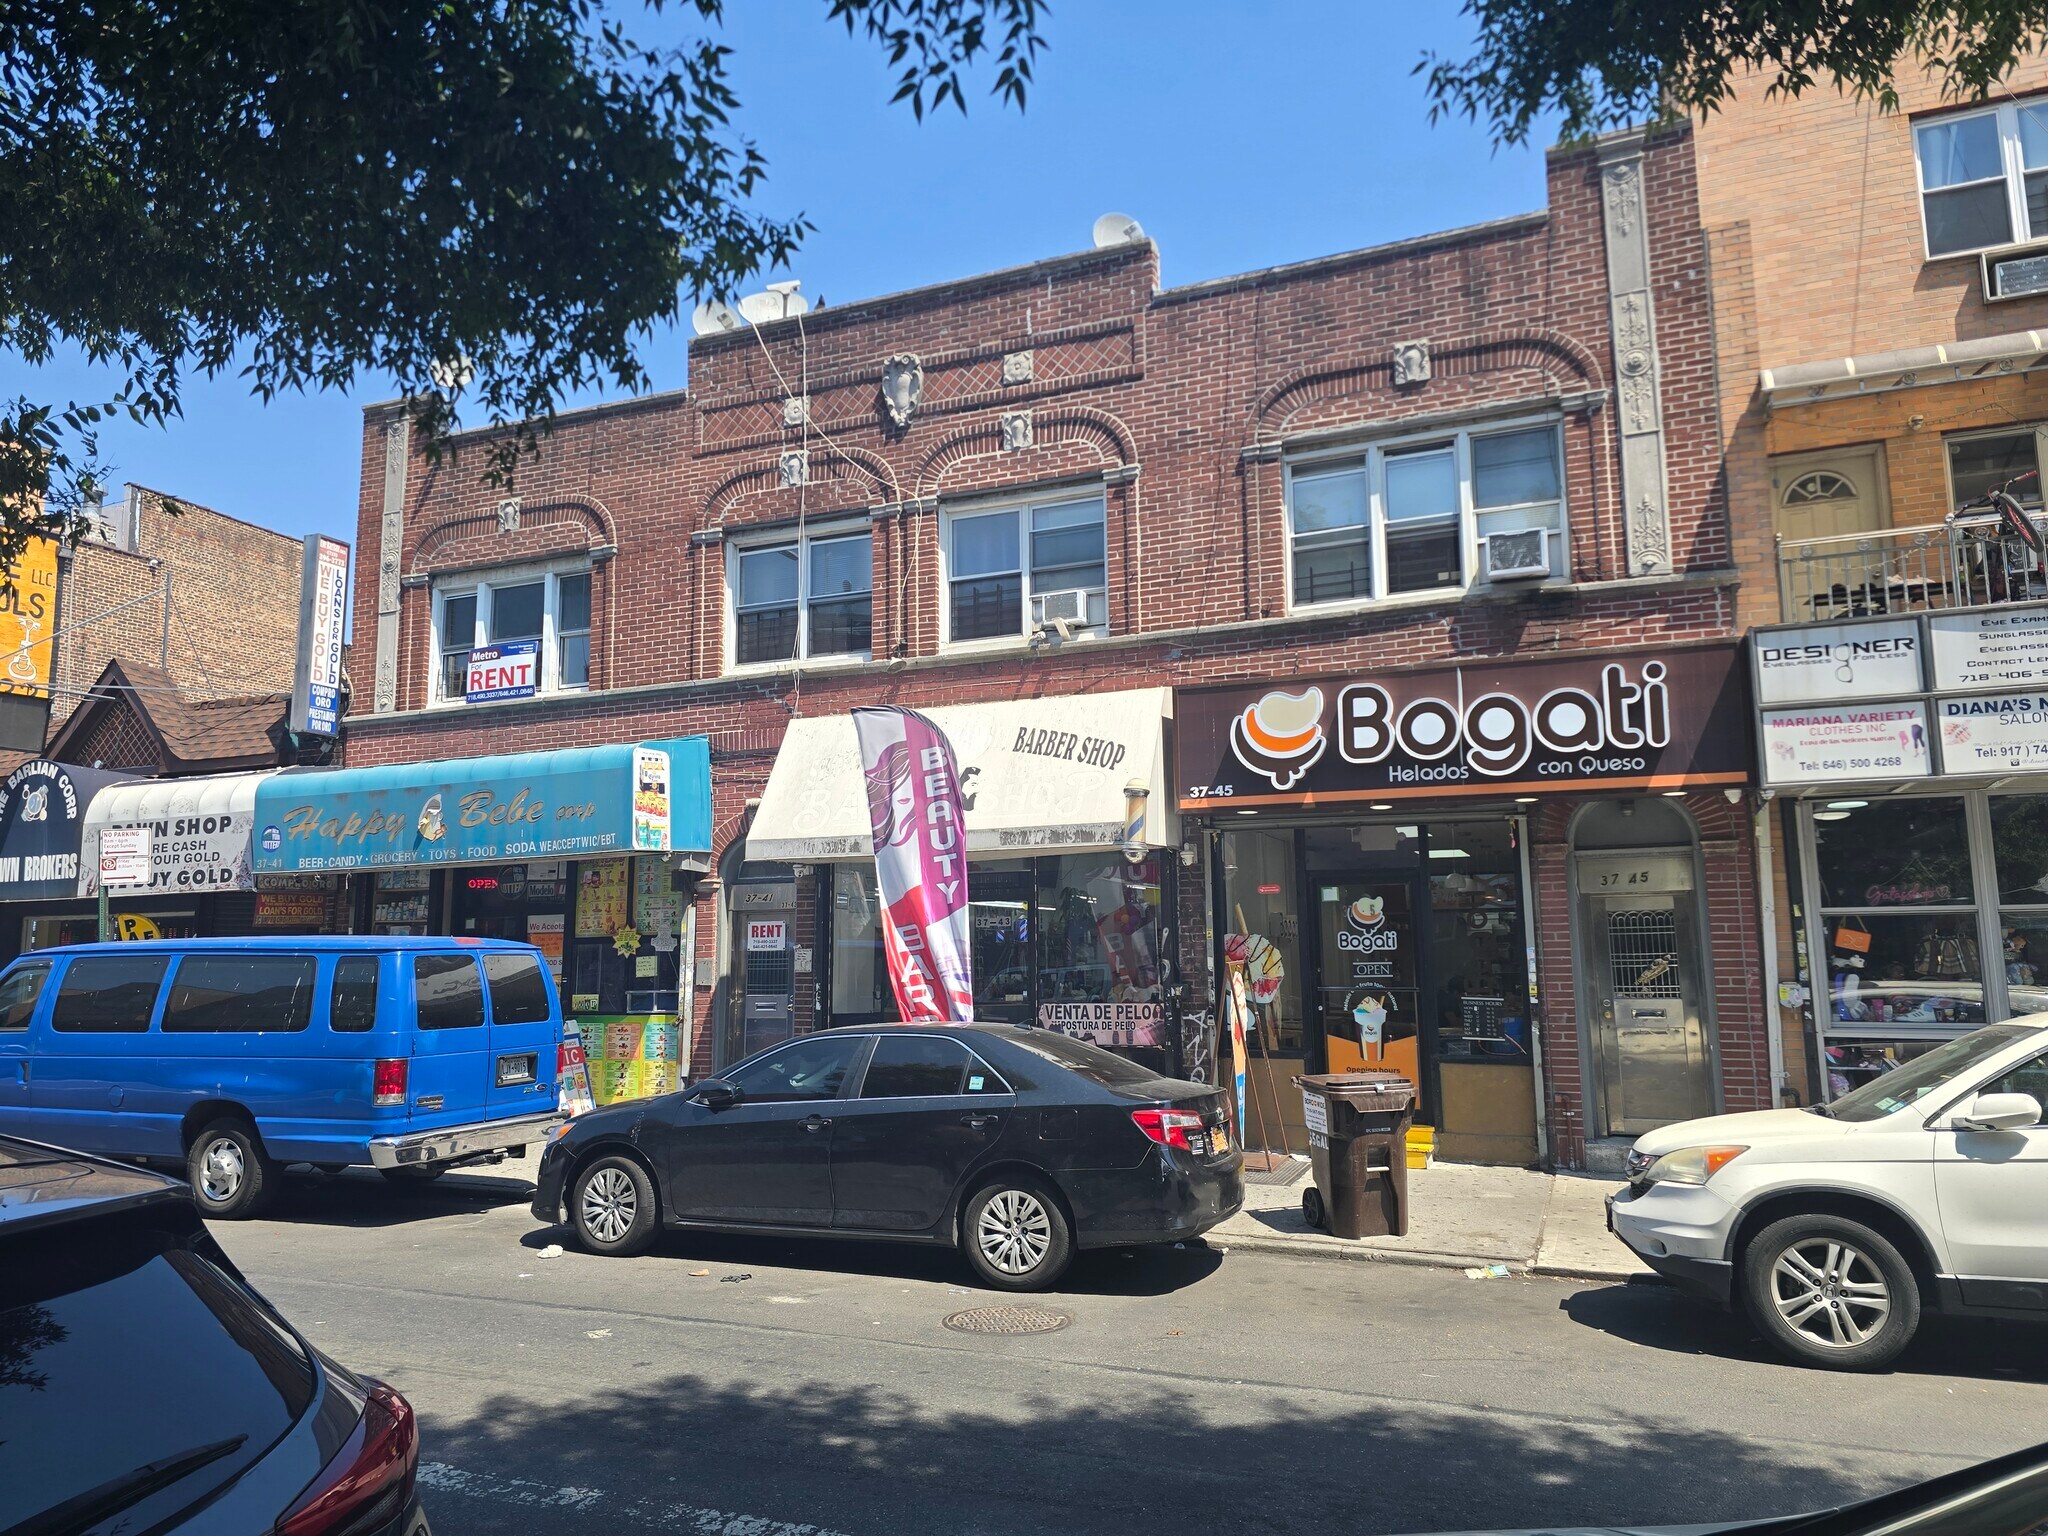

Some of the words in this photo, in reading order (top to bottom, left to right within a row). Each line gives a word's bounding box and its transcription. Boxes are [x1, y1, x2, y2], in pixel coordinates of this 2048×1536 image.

[32, 569, 56, 588] LLC.
[320, 564, 332, 590] WE
[333, 569, 343, 618] LOANS
[318, 593, 329, 628] BUY
[332, 621, 340, 640] FOR
[314, 632, 326, 681] GOLD
[328, 642, 339, 684] GOLD
[472, 651, 498, 661] Metro
[1967, 658, 2023, 668] CONTACT
[470, 664, 532, 691] RENT
[312, 684, 336, 699] COMPRO
[315, 696, 331, 709] ORO
[1947, 698, 2032, 715] DIANA'S
[1337, 660, 1670, 776] Bogati
[1772, 715, 1843, 728] MARIANA
[1848, 710, 1916, 723] VARIETY
[1809, 725, 1863, 736] CLOTHES
[1866, 723, 1887, 733] INC
[1012, 726, 1079, 761] BARBER
[1077, 736, 1126, 771] SHOP
[1975, 747, 1997, 757] Tel:
[2000, 746, 2021, 756] 917
[1388, 764, 1469, 783] Helados
[1537, 759, 1574, 775] con
[1578, 755, 1646, 776] Queso
[1799, 762, 1820, 771] Tel:
[1822, 759, 1847, 771] 646)
[1850, 759, 1870, 768] 500
[1874, 757, 1902, 767] 4268
[0, 790, 9, 821] HE
[7, 761, 59, 790] BARLIAN
[1189, 784, 1234, 798] 37-45
[283, 805, 406, 846] Happy
[457, 787, 544, 828] Bebe
[556, 801, 597, 822] corp
[174, 815, 232, 836] SHOP
[920, 746, 961, 905] BEAUTY
[172, 840, 207, 852] CASH
[256, 859, 282, 868] 37-41
[299, 857, 324, 868] BEER
[328, 855, 363, 867] CANDY
[370, 852, 418, 863] GROCERY
[429, 849, 456, 861] TOYS
[467, 846, 497, 858] FOOD
[505, 840, 537, 855] SODA
[151, 853, 180, 866] OUR
[184, 851, 220, 863] GOLD
[24, 852, 78, 882] BROKERS
[177, 868, 233, 885] GOLD
[468, 878, 498, 889] OPEN
[1600, 873, 1619, 886] 37
[1628, 870, 1649, 885] 45
[529, 884, 554, 896] Modelo
[745, 893, 774, 903] 37-41
[261, 894, 276, 903] WE
[277, 895, 297, 903] BUY
[300, 895, 324, 903] GOLD
[287, 907, 303, 915] FOR
[124, 919, 136, 932] P
[977, 918, 1010, 926] 37-43
[751, 925, 782, 938] RENT
[1338, 931, 1398, 954] Bogati
[898, 924, 944, 1022] BAR
[1356, 964, 1390, 975] OPEN
[1045, 1005, 1090, 1020] VENTA
[1094, 1005, 1111, 1020] DE
[1116, 1005, 1151, 1020] PELO
[1061, 1020, 1099, 1031] POSTURA
[1101, 1021, 1112, 1030] DE
[1115, 1020, 1136, 1031] PELO
[1346, 1066, 1378, 1074] Opening
[1379, 1066, 1401, 1074] hours
